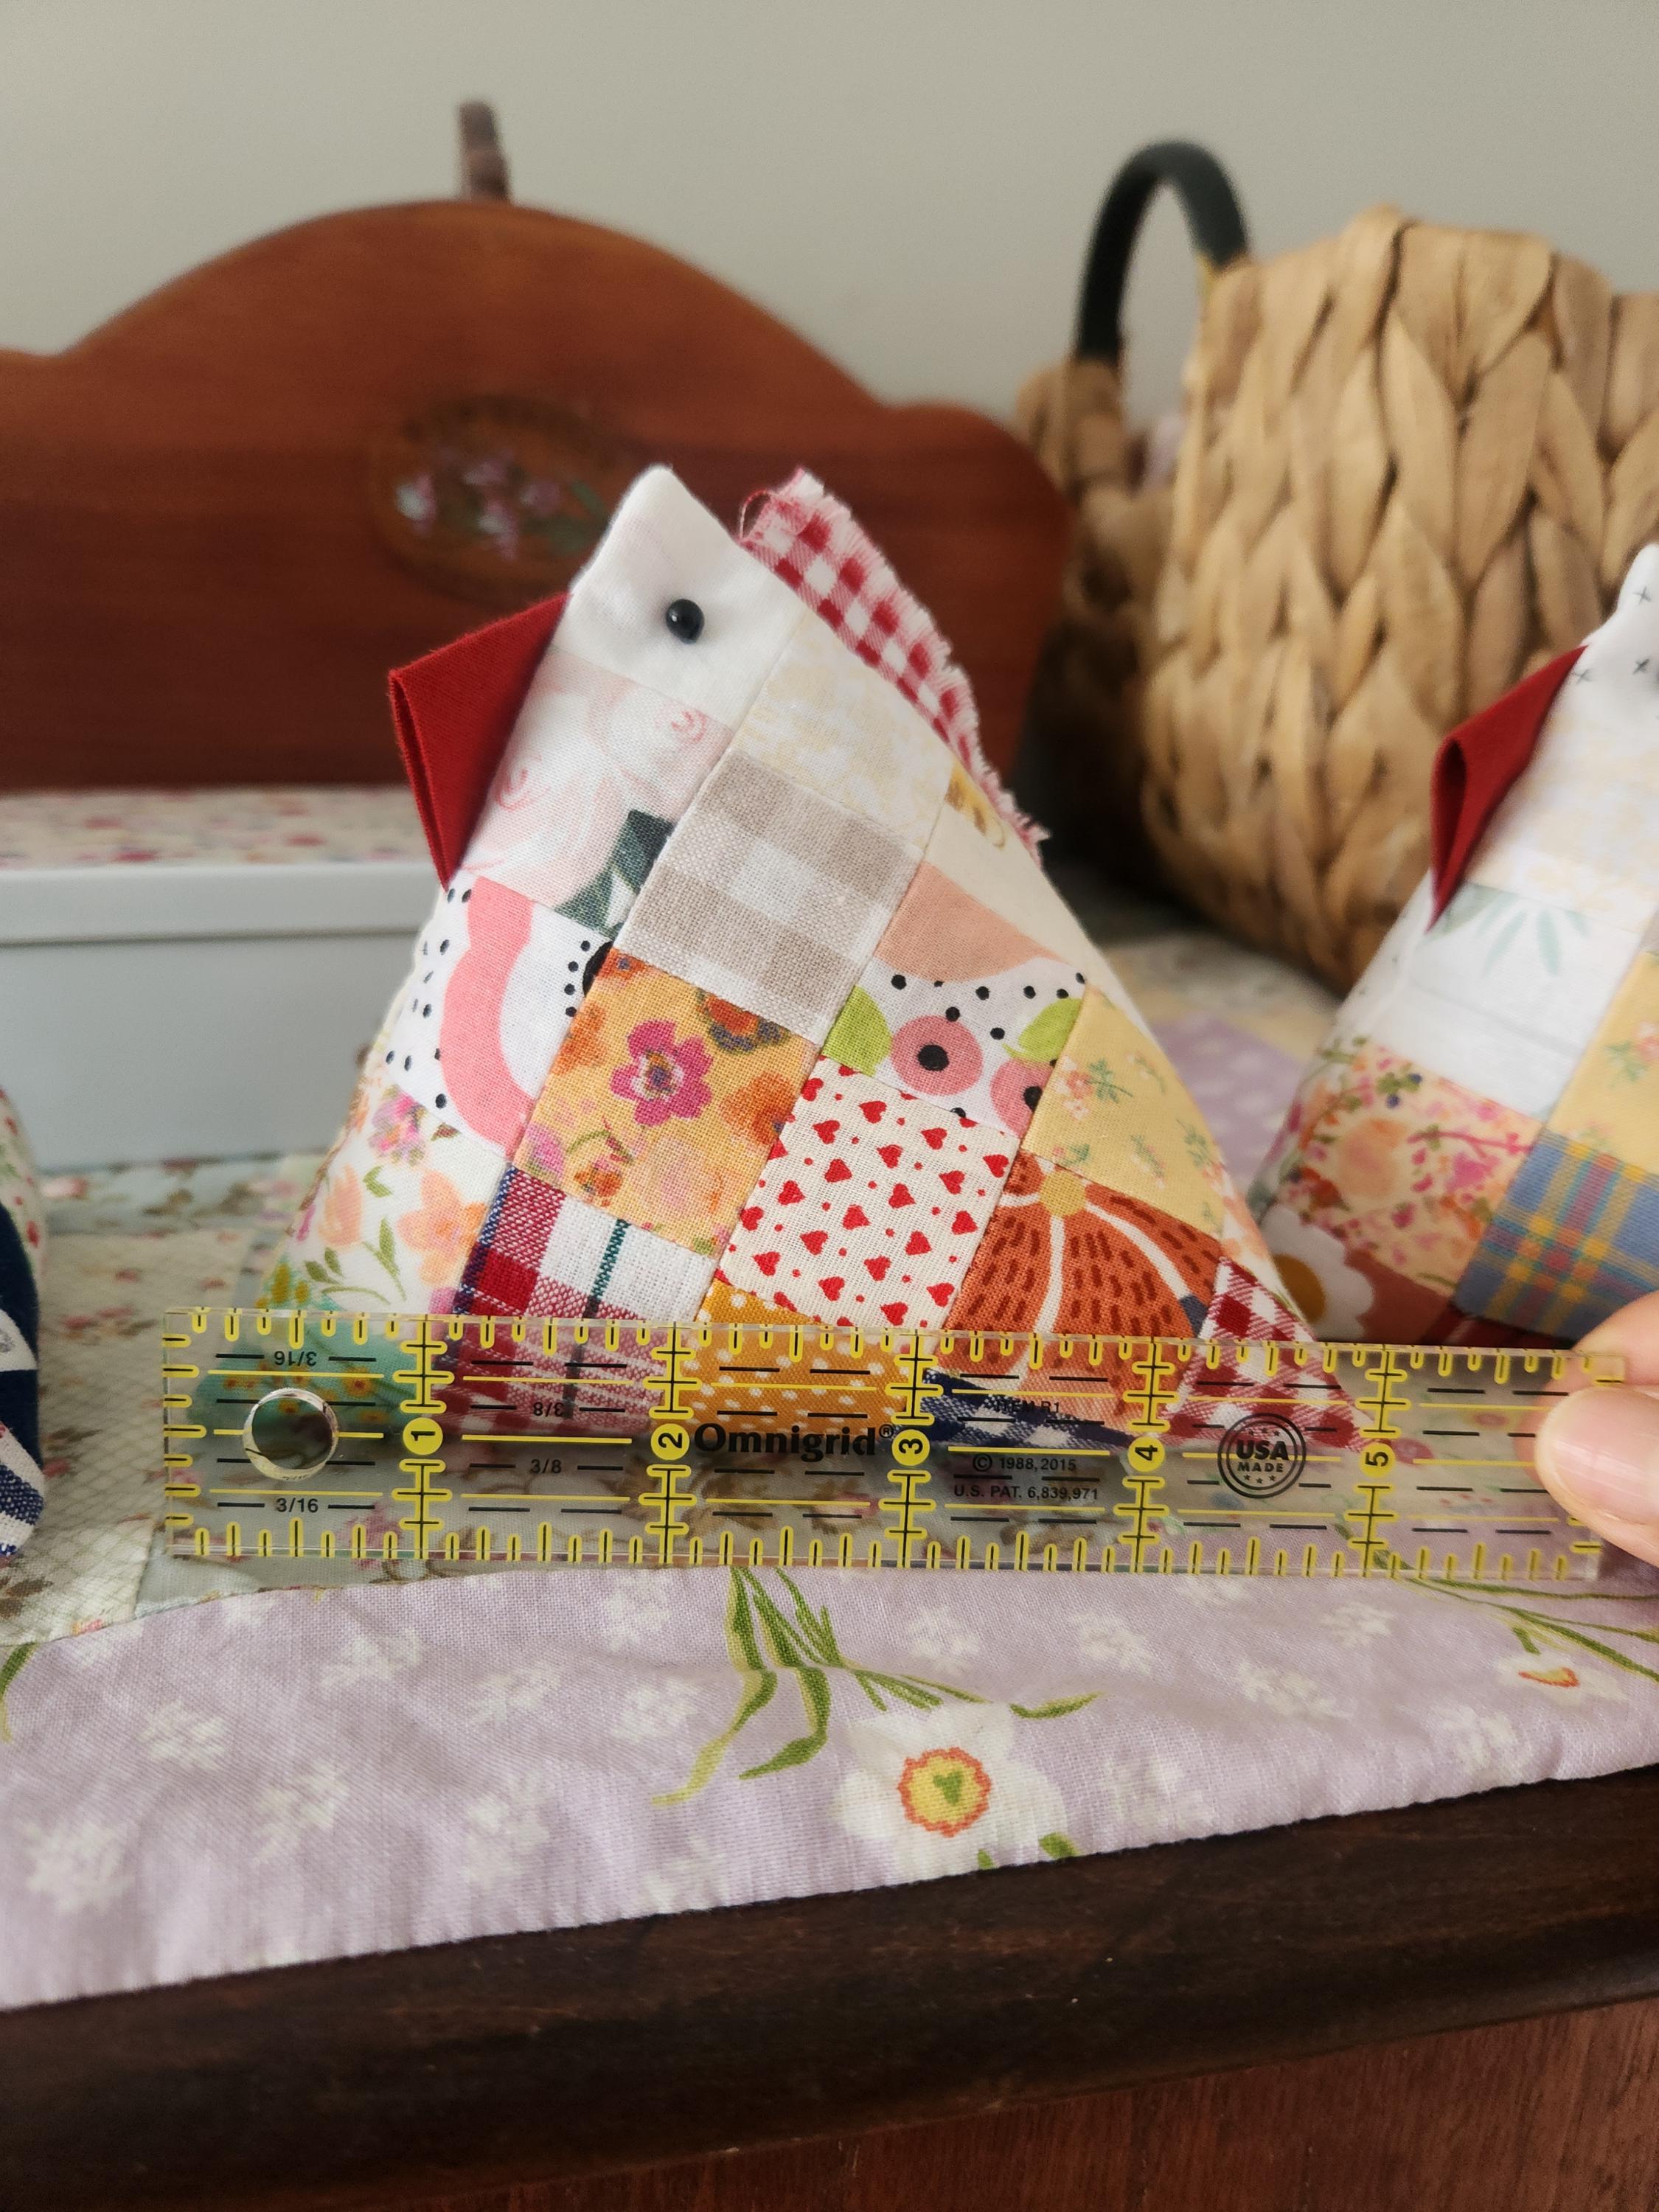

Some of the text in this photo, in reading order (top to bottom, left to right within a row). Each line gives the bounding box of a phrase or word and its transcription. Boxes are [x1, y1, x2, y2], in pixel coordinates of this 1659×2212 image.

[274, 1350, 318, 1366] 3/16
[532, 1401, 564, 1417] 3/8
[410, 1430, 436, 1441] 1
[658, 1432, 683, 1450] 2
[898, 1438, 924, 1455] 3
[1134, 1444, 1158, 1461] 4
[1236, 1439, 1290, 1461] USA
[530, 1458, 562, 1474] 3/8
[1237, 1461, 1284, 1473] MADE
[1364, 1451, 1389, 1467] 5
[954, 1484, 1099, 1500] U.S. PAT. 6,839,971
[276, 1497, 319, 1514] 3/16
